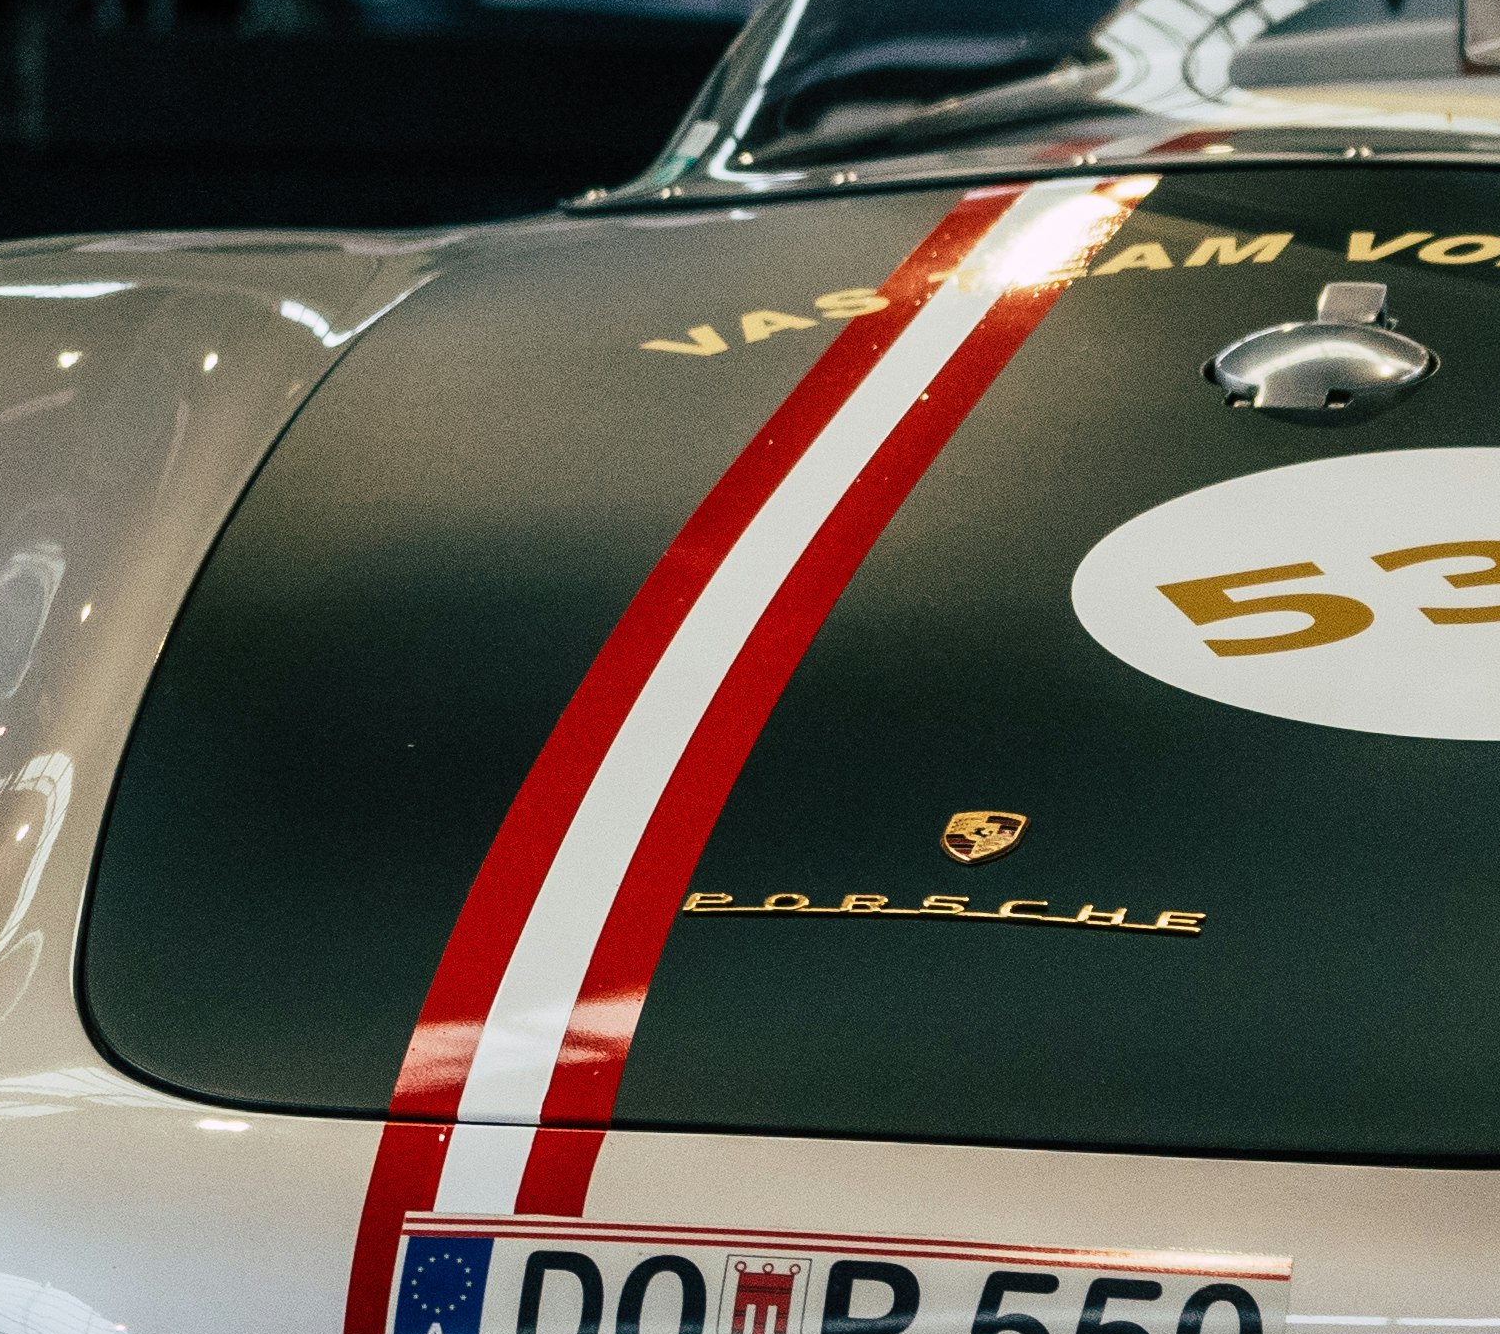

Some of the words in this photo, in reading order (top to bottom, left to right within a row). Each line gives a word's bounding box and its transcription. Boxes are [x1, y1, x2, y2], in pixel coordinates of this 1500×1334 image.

[639, 287, 891, 357] VAS
[927, 232, 1294, 289] TAM
[682, 891, 1206, 934] PORSCHE
